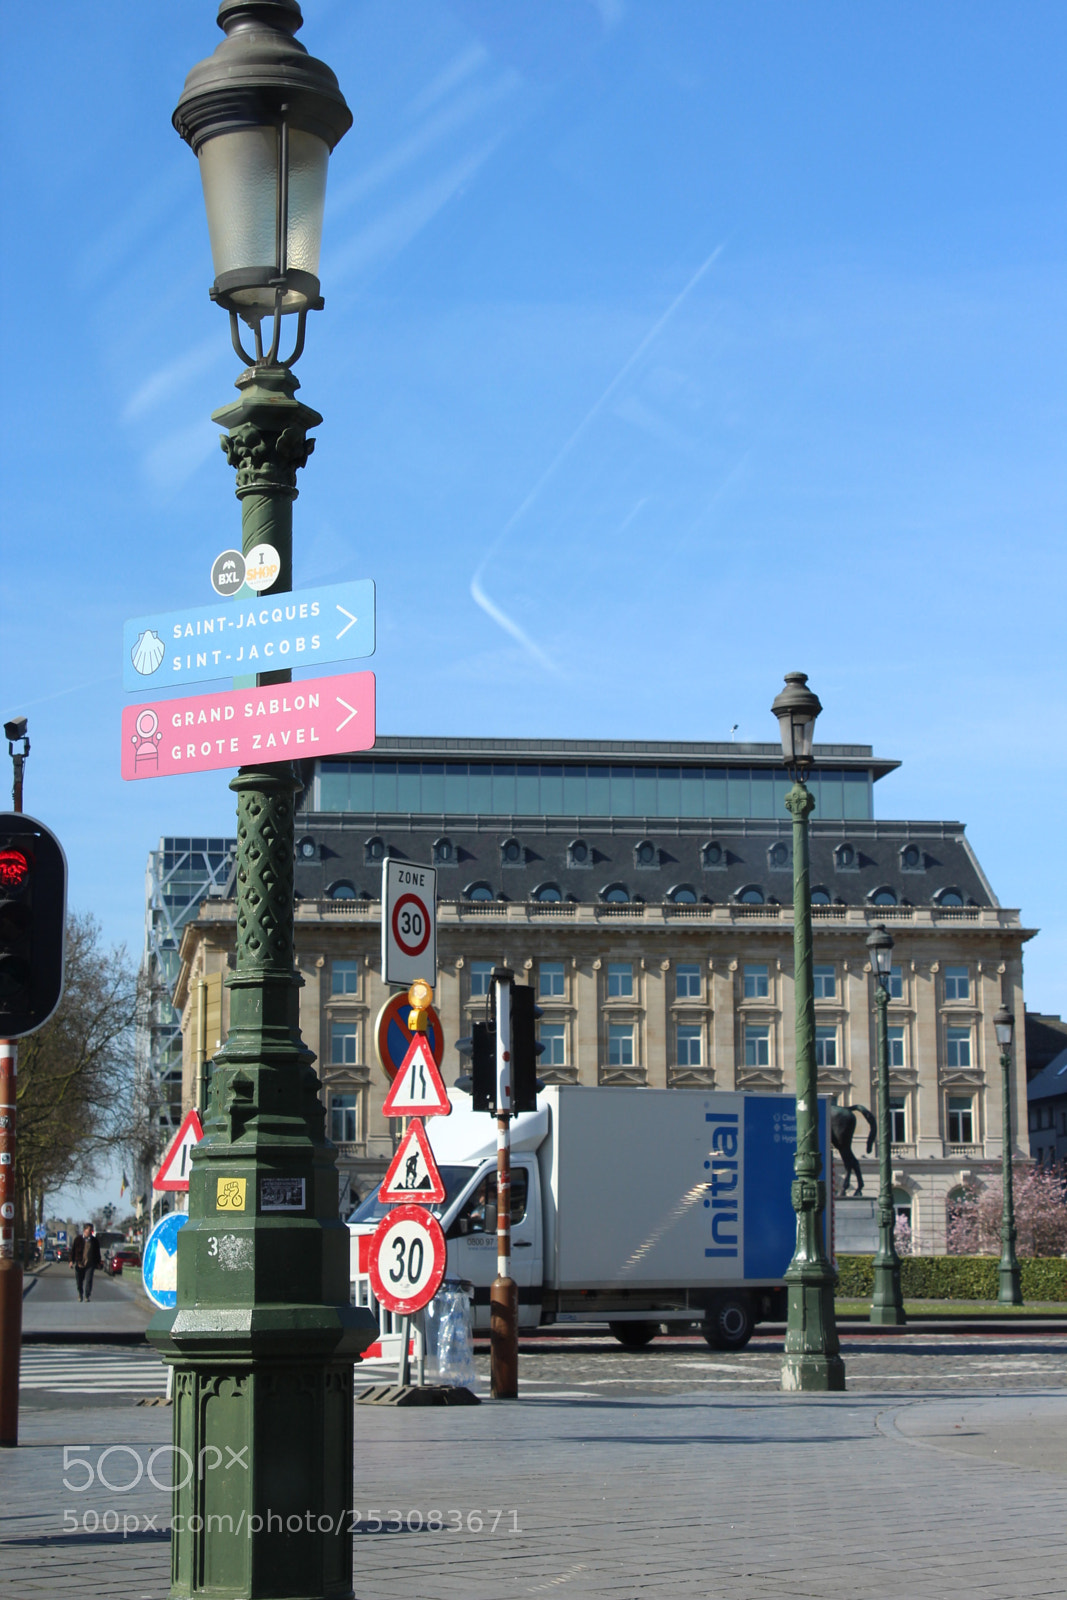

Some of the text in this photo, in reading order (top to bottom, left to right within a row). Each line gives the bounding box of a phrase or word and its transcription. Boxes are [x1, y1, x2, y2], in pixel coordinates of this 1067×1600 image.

[218, 571, 240, 586] BXL
[246, 564, 278, 582] SHOP
[173, 602, 320, 639] SAINT-JACQUES
[173, 635, 321, 671] SINT-JACOBS
[172, 693, 320, 728] GRAND SABLON
[171, 727, 320, 760] GROTE ZAVEL
[398, 870, 425, 887] ZONE
[401, 912, 422, 936] 30
[704, 1113, 739, 1258] Initial
[389, 1236, 424, 1285] 30
